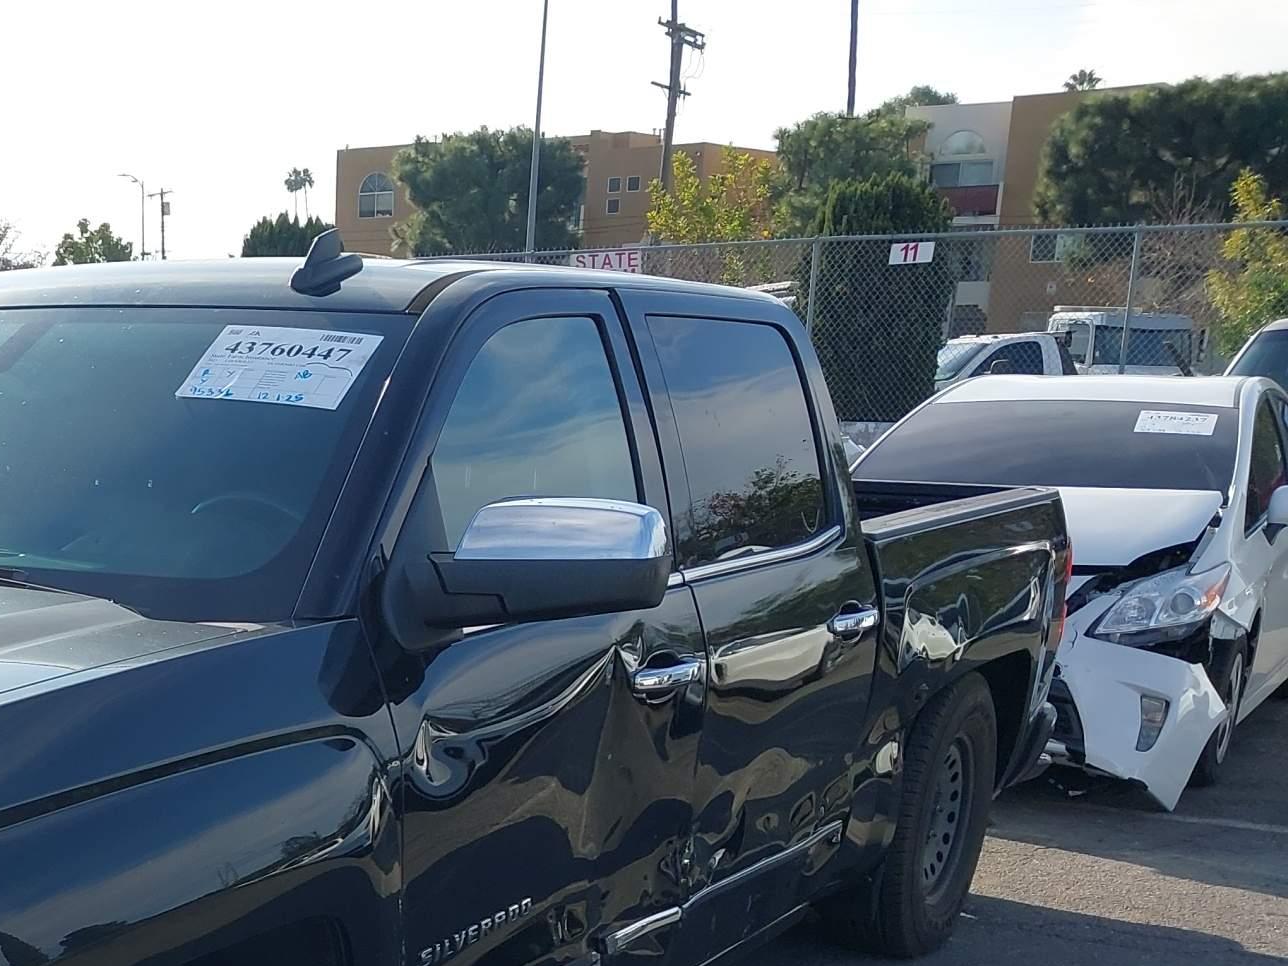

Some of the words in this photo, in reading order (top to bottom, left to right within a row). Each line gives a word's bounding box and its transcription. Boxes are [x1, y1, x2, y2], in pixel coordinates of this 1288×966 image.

[575, 251, 639, 270] STATE
[899, 243, 920, 262] 11
[224, 340, 354, 362] 43760447
